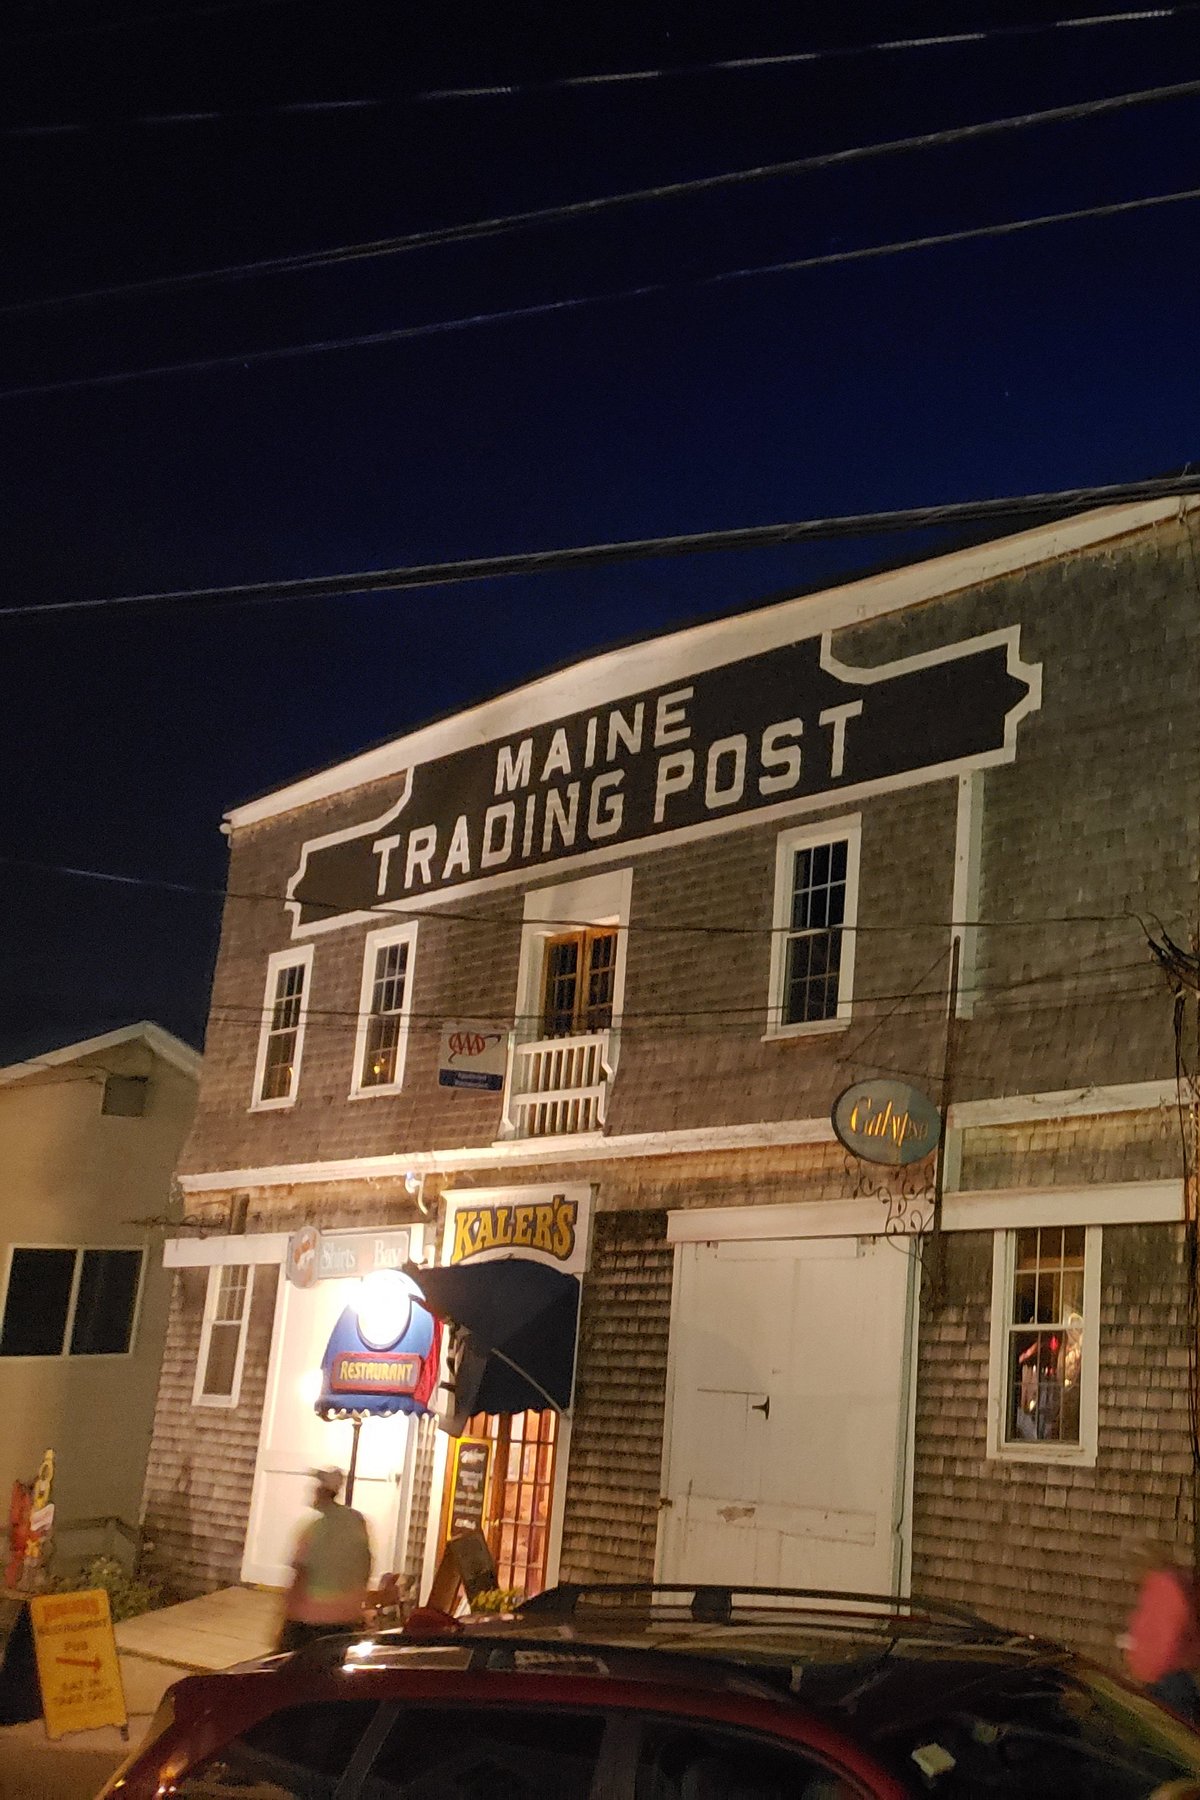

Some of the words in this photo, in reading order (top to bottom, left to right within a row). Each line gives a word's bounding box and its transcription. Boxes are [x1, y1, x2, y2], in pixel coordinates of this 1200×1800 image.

[494, 687, 695, 795] MAINE
[373, 772, 626, 896] TRADING
[653, 699, 864, 825] POST
[850, 1096, 929, 1151] Calypso
[452, 1195, 578, 1264] KALER'S
[340, 1360, 413, 1380] RESTAURANT
